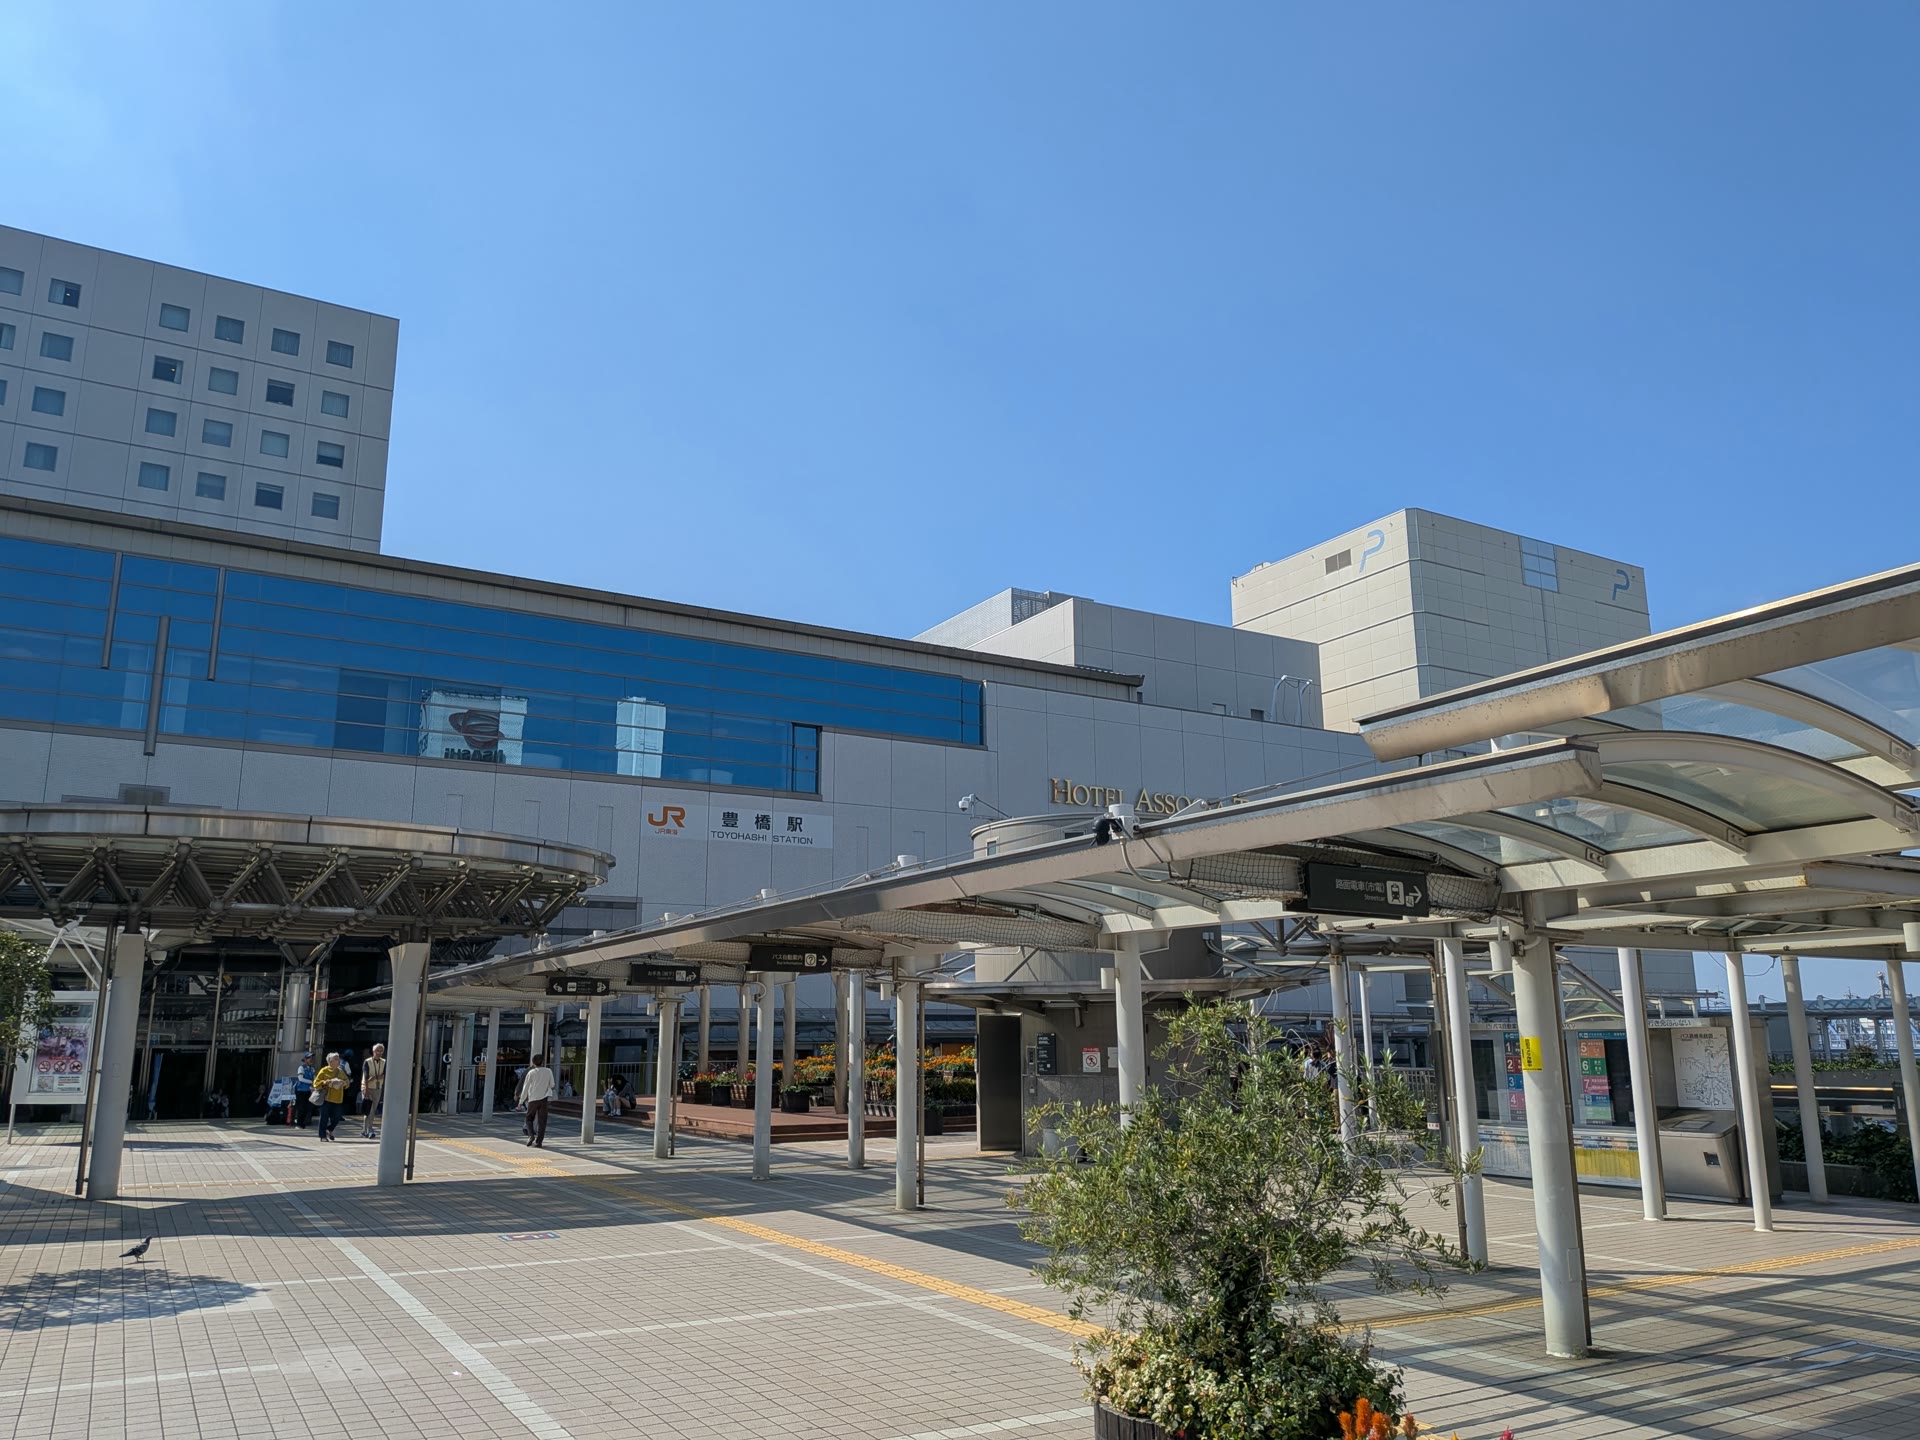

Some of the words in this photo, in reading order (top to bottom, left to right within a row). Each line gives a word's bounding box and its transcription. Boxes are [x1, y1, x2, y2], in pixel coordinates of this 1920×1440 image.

[1050, 777, 1124, 807] HOTEL
[647, 805, 686, 829] JR
[721, 811, 804, 833] 豊橋駅
[710, 830, 768, 842] TOYOHASHI
[772, 835, 814, 845] STATION
[1505, 1042, 1511, 1052] 1
[1580, 1042, 1587, 1053] 5
[1506, 1059, 1514, 1070] 2
[1582, 1060, 1589, 1071] 6
[1508, 1076, 1515, 1087] 3
[1583, 1078, 1590, 1089] 7
[1510, 1094, 1517, 1105] 4
